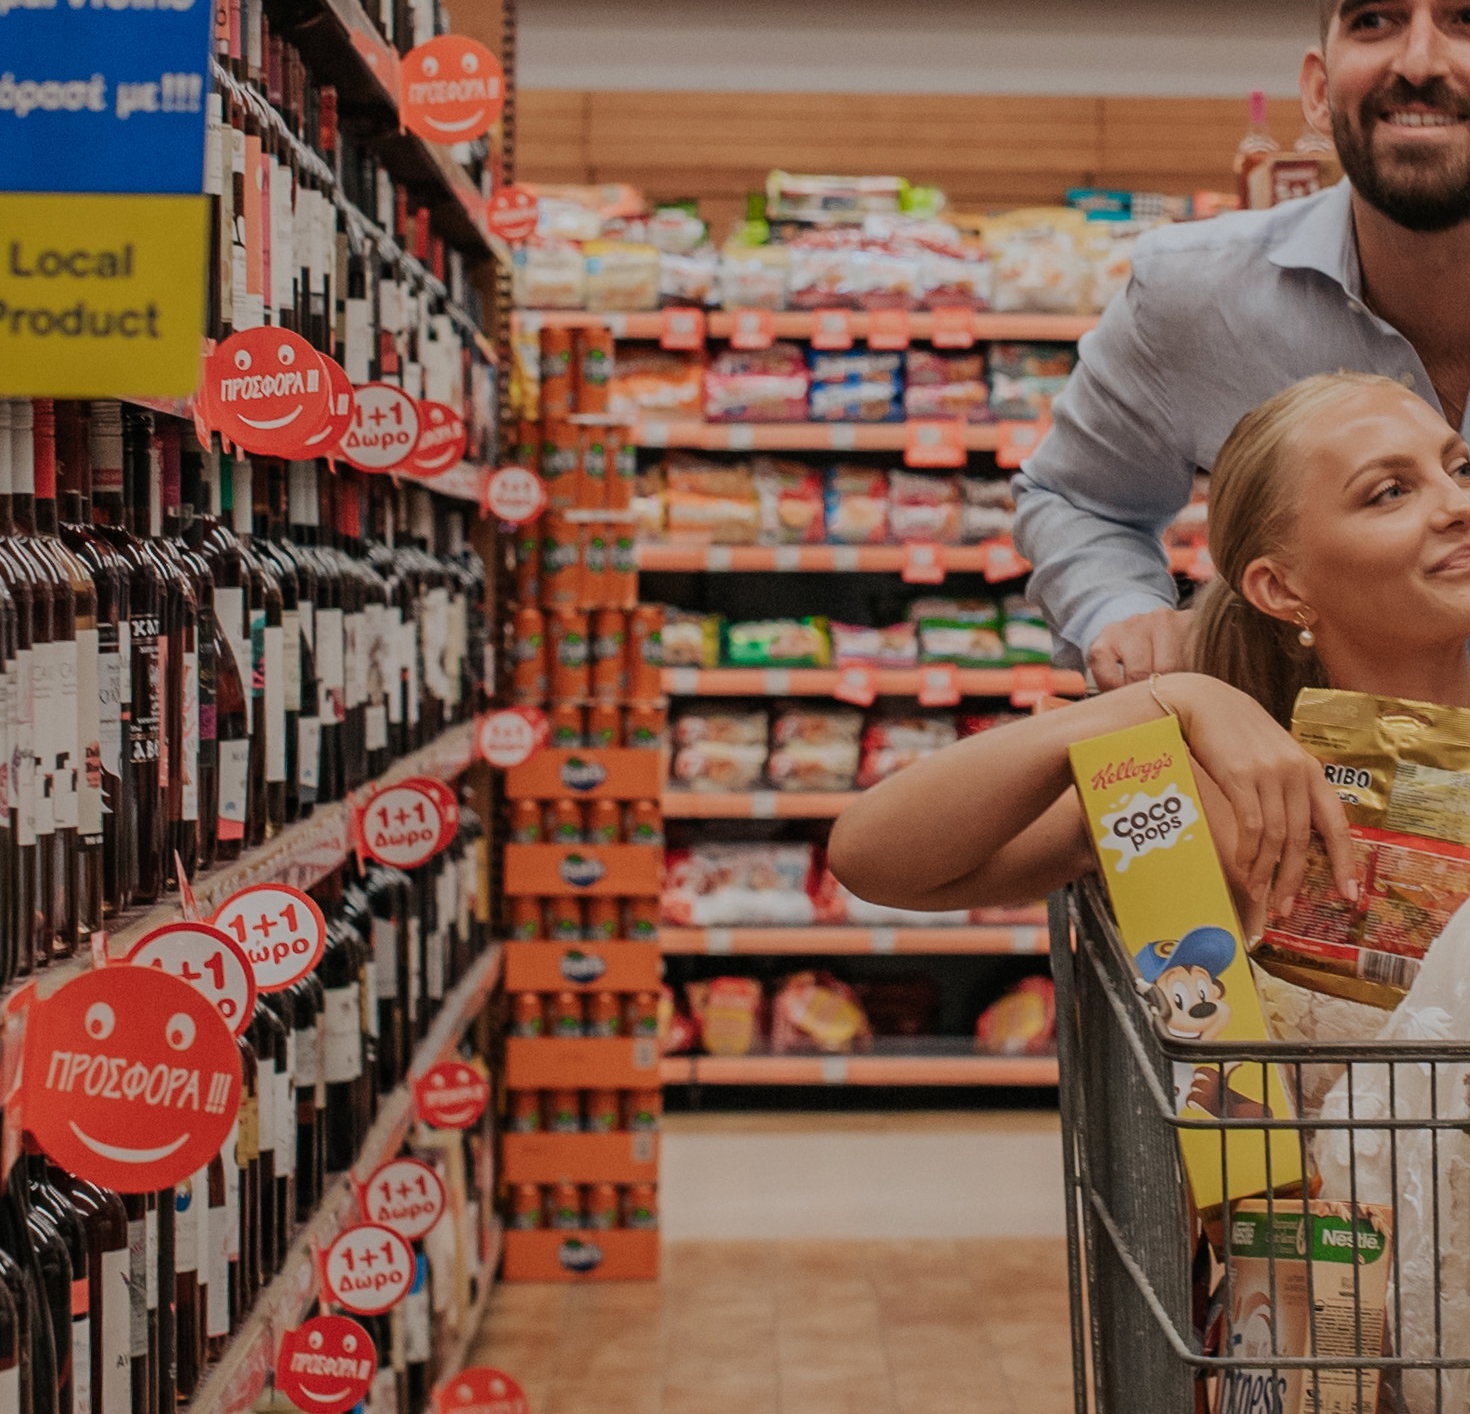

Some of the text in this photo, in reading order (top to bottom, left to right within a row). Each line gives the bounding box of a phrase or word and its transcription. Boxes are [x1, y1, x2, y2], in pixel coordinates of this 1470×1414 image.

[10, 241, 134, 279] Local
[220, 371, 304, 402] ΠΡΟΣΦΟΡΑ
[355, 403, 404, 428] 1+1
[1091, 753, 1173, 791] Kellogg's
[1131, 816, 1182, 852] pops
[228, 903, 298, 944] 1+1
[248, 937, 311, 966] ώρο
[45, 1049, 201, 1112] ΠΡΟΣΦΟΡΑ
[340, 1241, 396, 1272] 1+1
